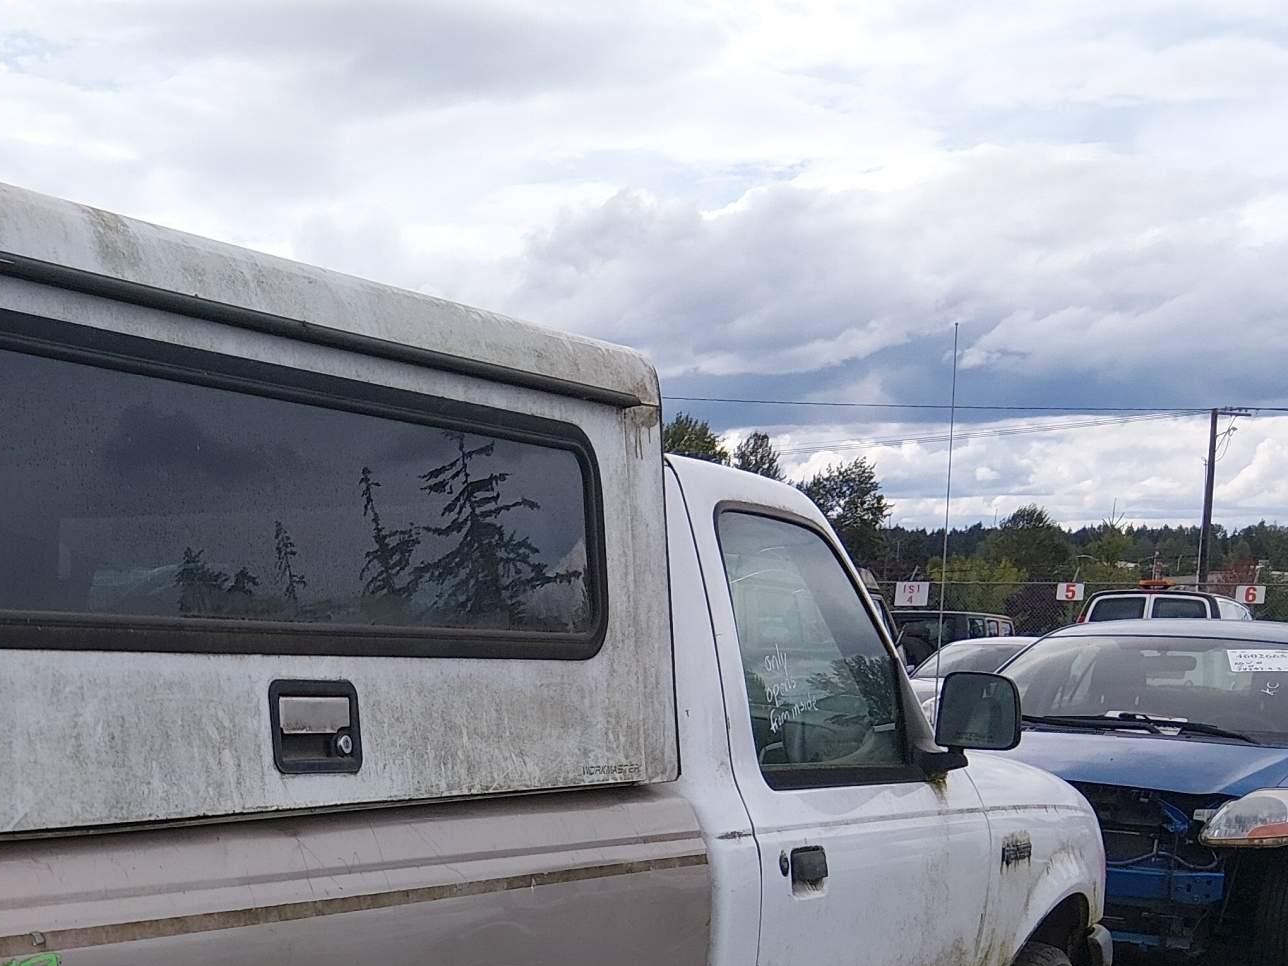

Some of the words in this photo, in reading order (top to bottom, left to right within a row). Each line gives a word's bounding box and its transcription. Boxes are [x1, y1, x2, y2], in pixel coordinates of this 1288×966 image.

[1064, 584, 1076, 600] 5
[1244, 586, 1257, 603] 6
[764, 643, 789, 678] only
